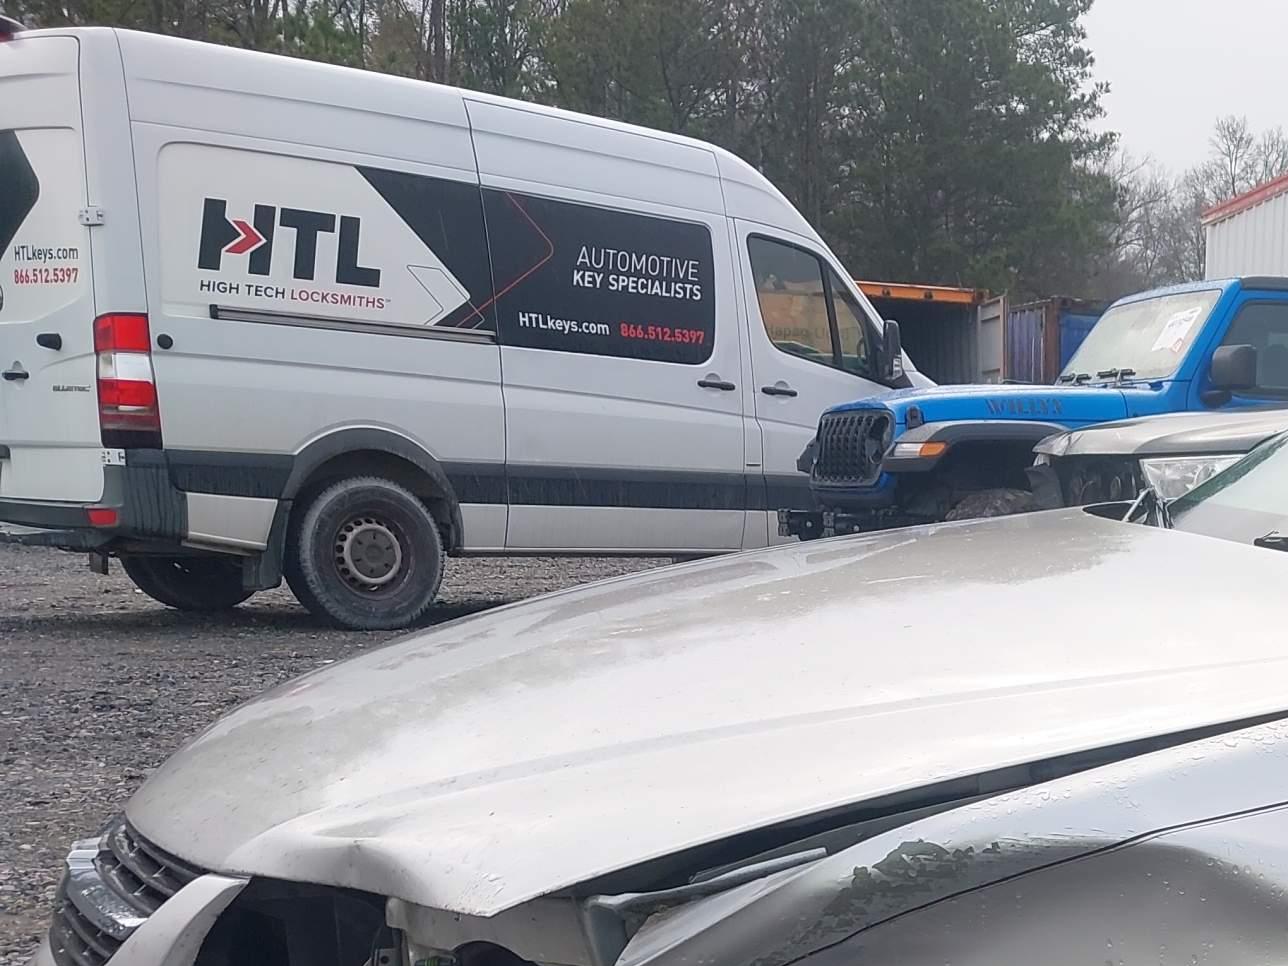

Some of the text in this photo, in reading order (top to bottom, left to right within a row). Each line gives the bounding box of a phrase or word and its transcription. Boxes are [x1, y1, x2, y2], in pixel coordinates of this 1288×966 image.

[14, 245, 79, 263] HTLkeys.com
[198, 197, 382, 289] HTL
[14, 267, 79, 284] 866.512.5397
[576, 246, 700, 281] AUTOMOTIVE
[200, 279, 386, 309] HIGH TECH LOCKSMITHS
[573, 269, 702, 301] KEY SPECIALISTS
[518, 311, 705, 344] HTLkeys.com 866.512.5397
